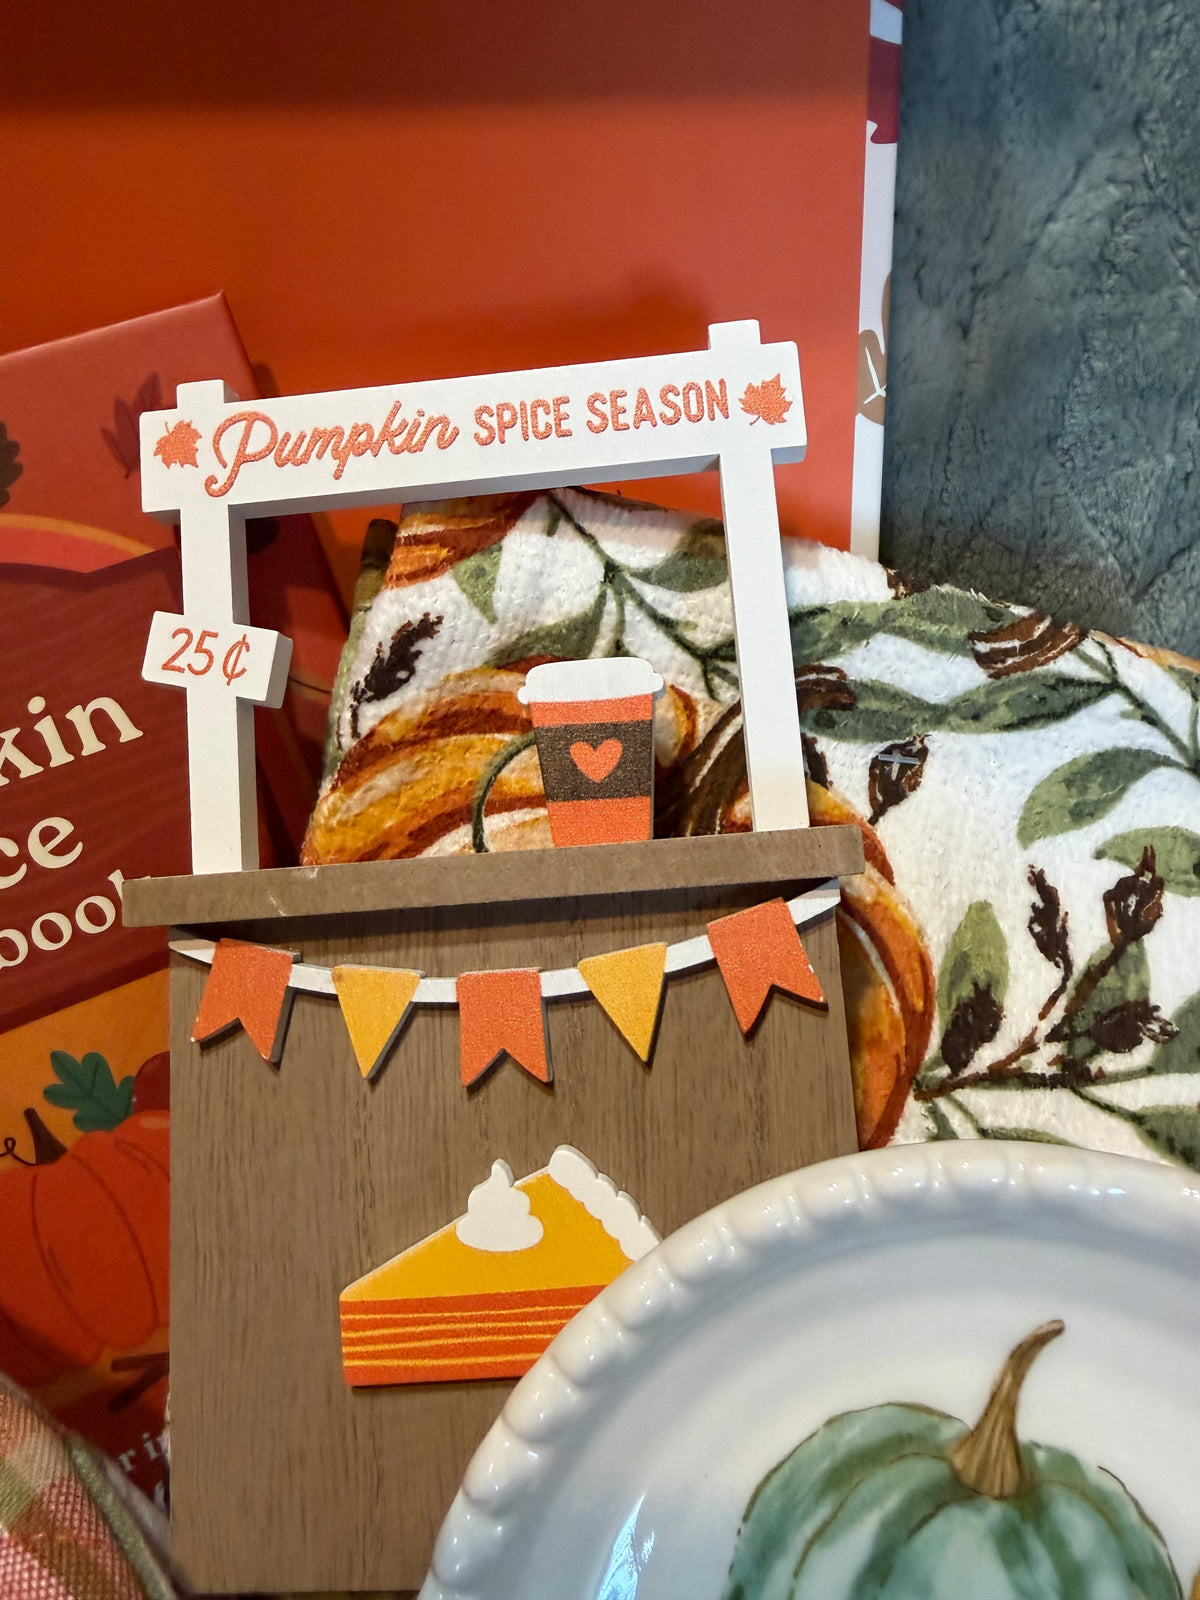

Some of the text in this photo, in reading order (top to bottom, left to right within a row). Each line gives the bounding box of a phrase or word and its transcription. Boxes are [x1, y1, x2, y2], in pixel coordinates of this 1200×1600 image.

[204, 377, 730, 498] Pumpkin SPICE SEASON
[161, 626, 251, 686] 25¢
